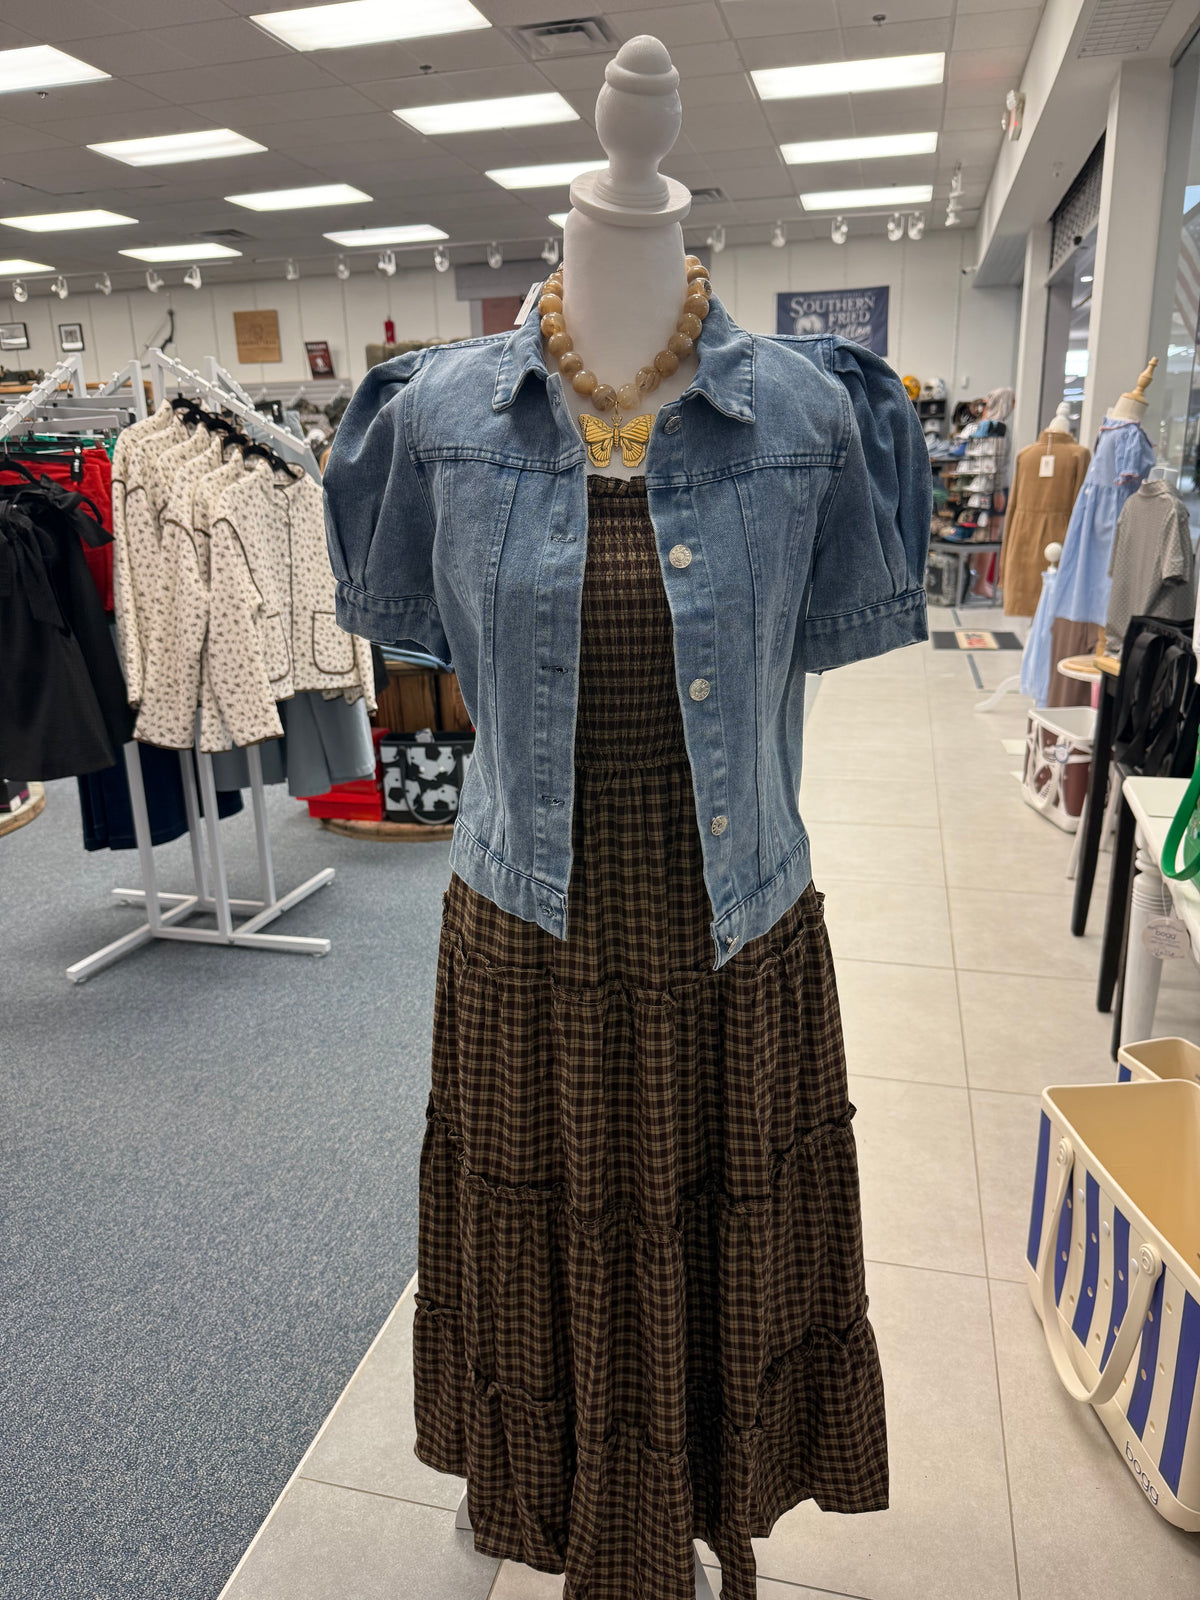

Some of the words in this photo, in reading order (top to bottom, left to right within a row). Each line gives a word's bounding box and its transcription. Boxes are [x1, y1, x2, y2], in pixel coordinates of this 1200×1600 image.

[789, 296, 875, 319] SOUTHERN
[828, 310, 871, 327] FRIED
[1126, 1440, 1159, 1506] bogg
